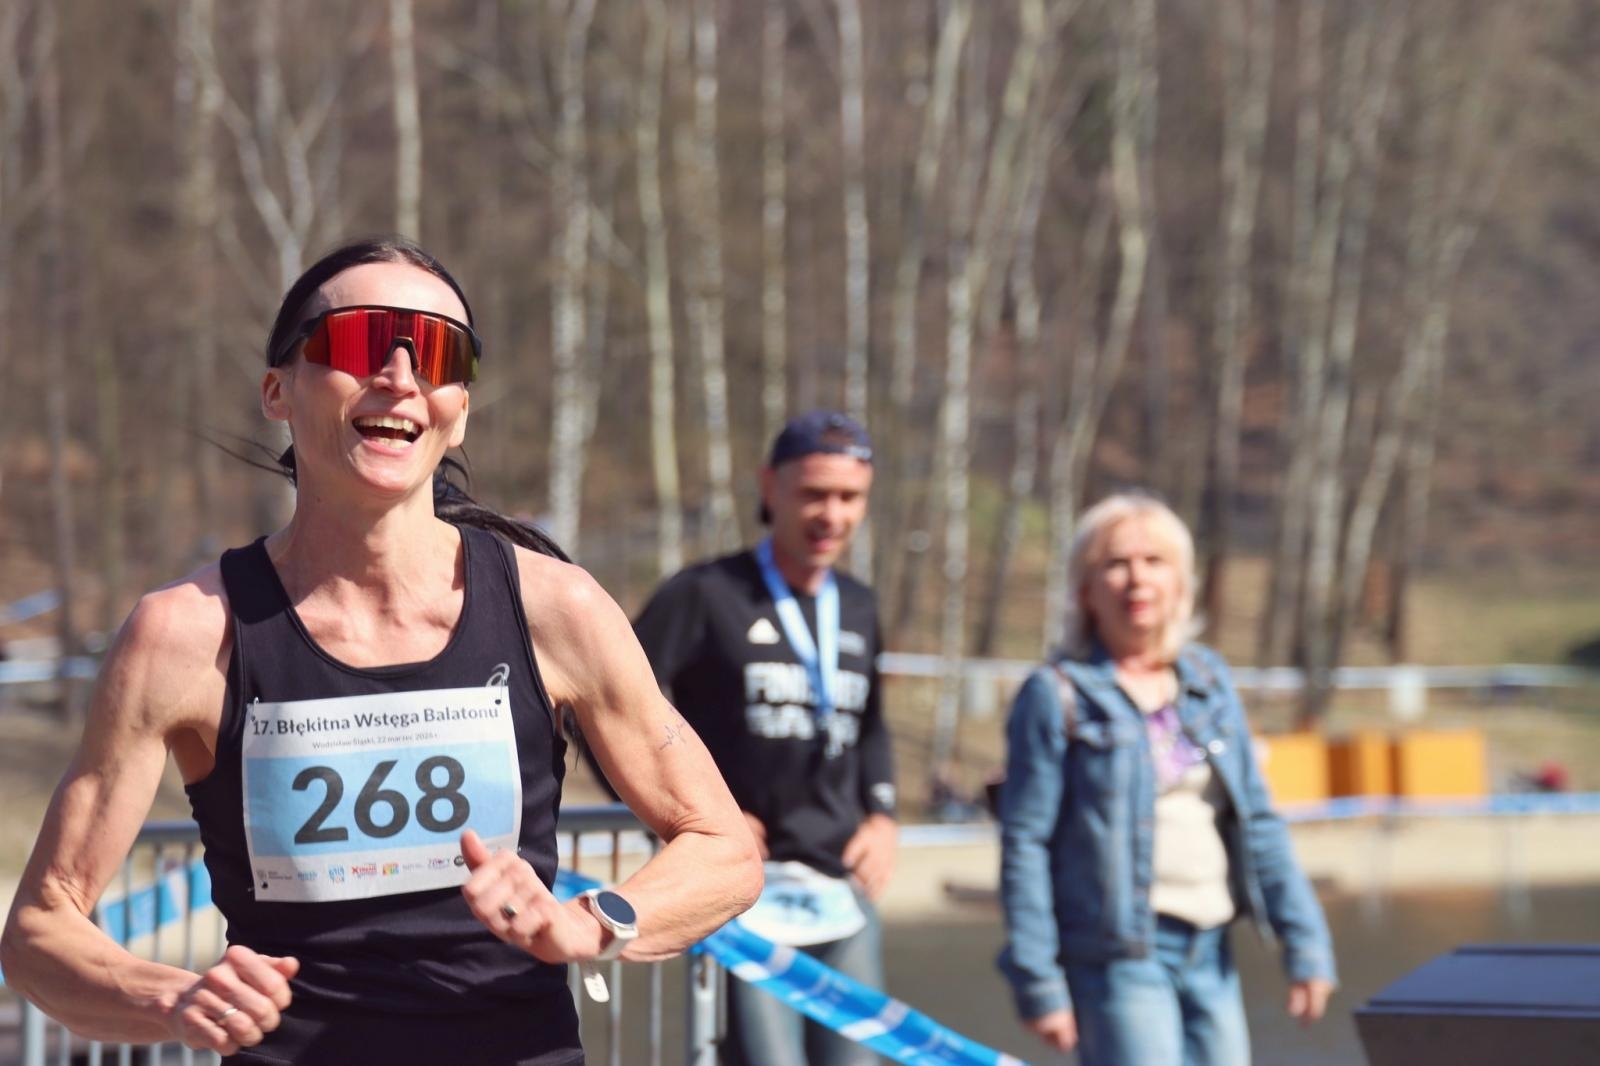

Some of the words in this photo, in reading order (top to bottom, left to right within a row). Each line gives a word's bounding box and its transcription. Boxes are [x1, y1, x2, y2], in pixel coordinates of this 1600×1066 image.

[253, 719, 274, 735] 17.
[277, 716, 351, 736] Błękitna
[354, 712, 420, 728] Wstęga
[423, 705, 499, 723] Balatonu
[292, 755, 471, 845] 268
